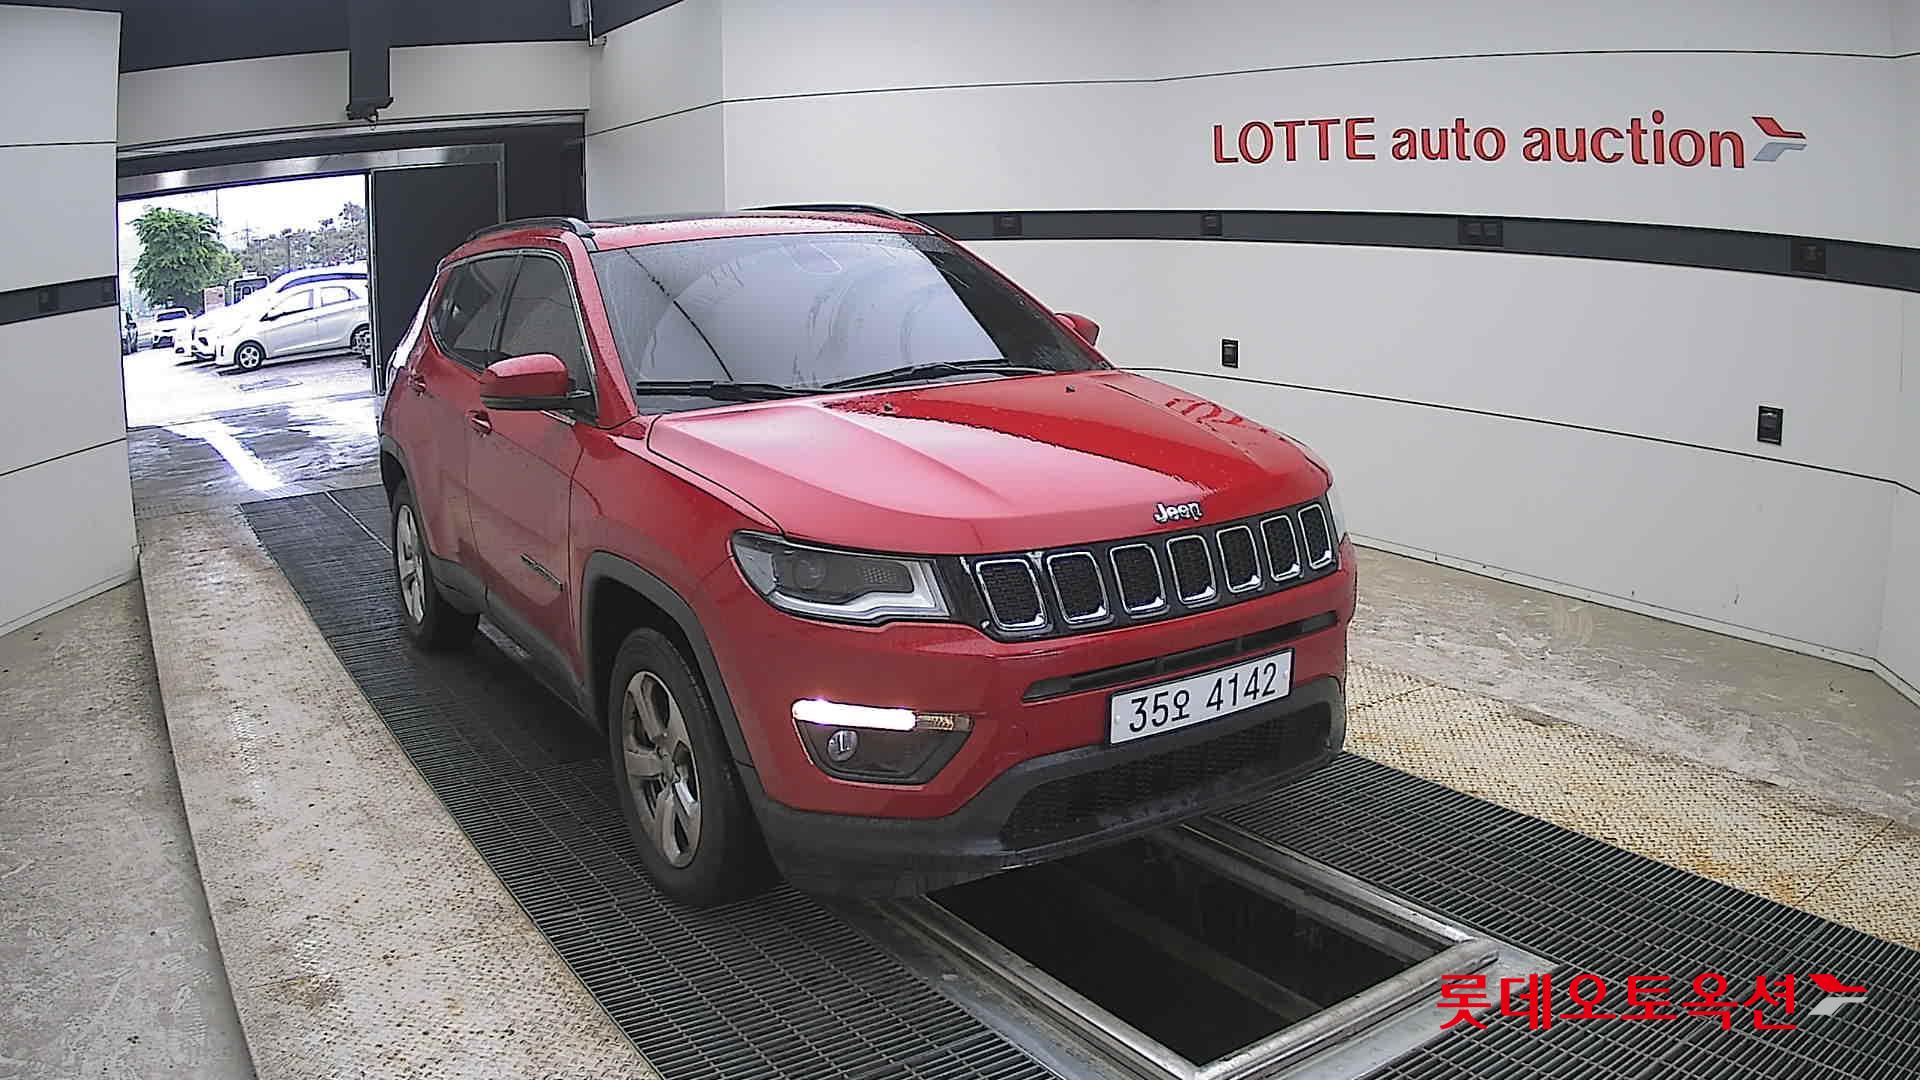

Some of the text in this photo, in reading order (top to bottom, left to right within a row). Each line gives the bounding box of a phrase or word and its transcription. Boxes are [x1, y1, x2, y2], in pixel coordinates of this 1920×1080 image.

[1212, 109, 1745, 169] LOTTE auto auction
[1153, 501, 1203, 523] Jeep
[1128, 662, 1278, 733] 35오 4142
